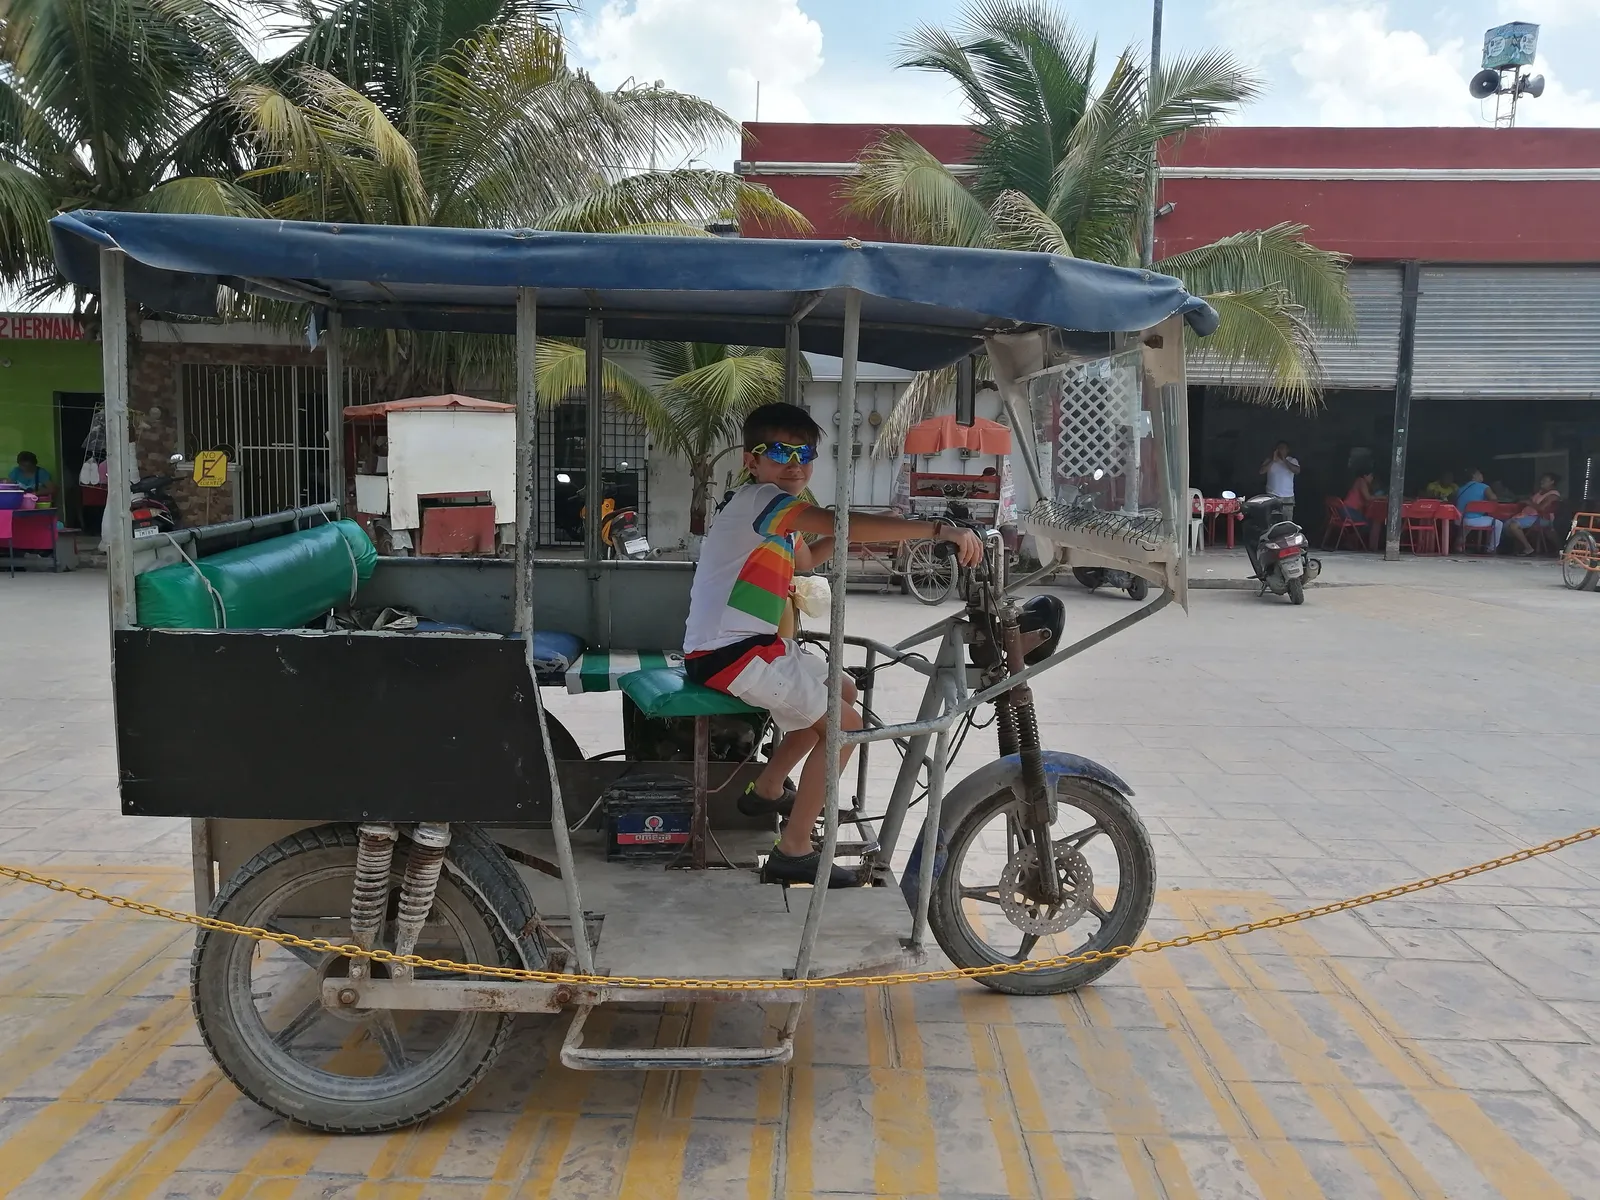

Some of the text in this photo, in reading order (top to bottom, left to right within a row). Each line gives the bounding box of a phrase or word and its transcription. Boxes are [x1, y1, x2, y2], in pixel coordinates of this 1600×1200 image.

[0, 317, 84, 340] 2 HERMANA
[203, 460, 216, 478] E
